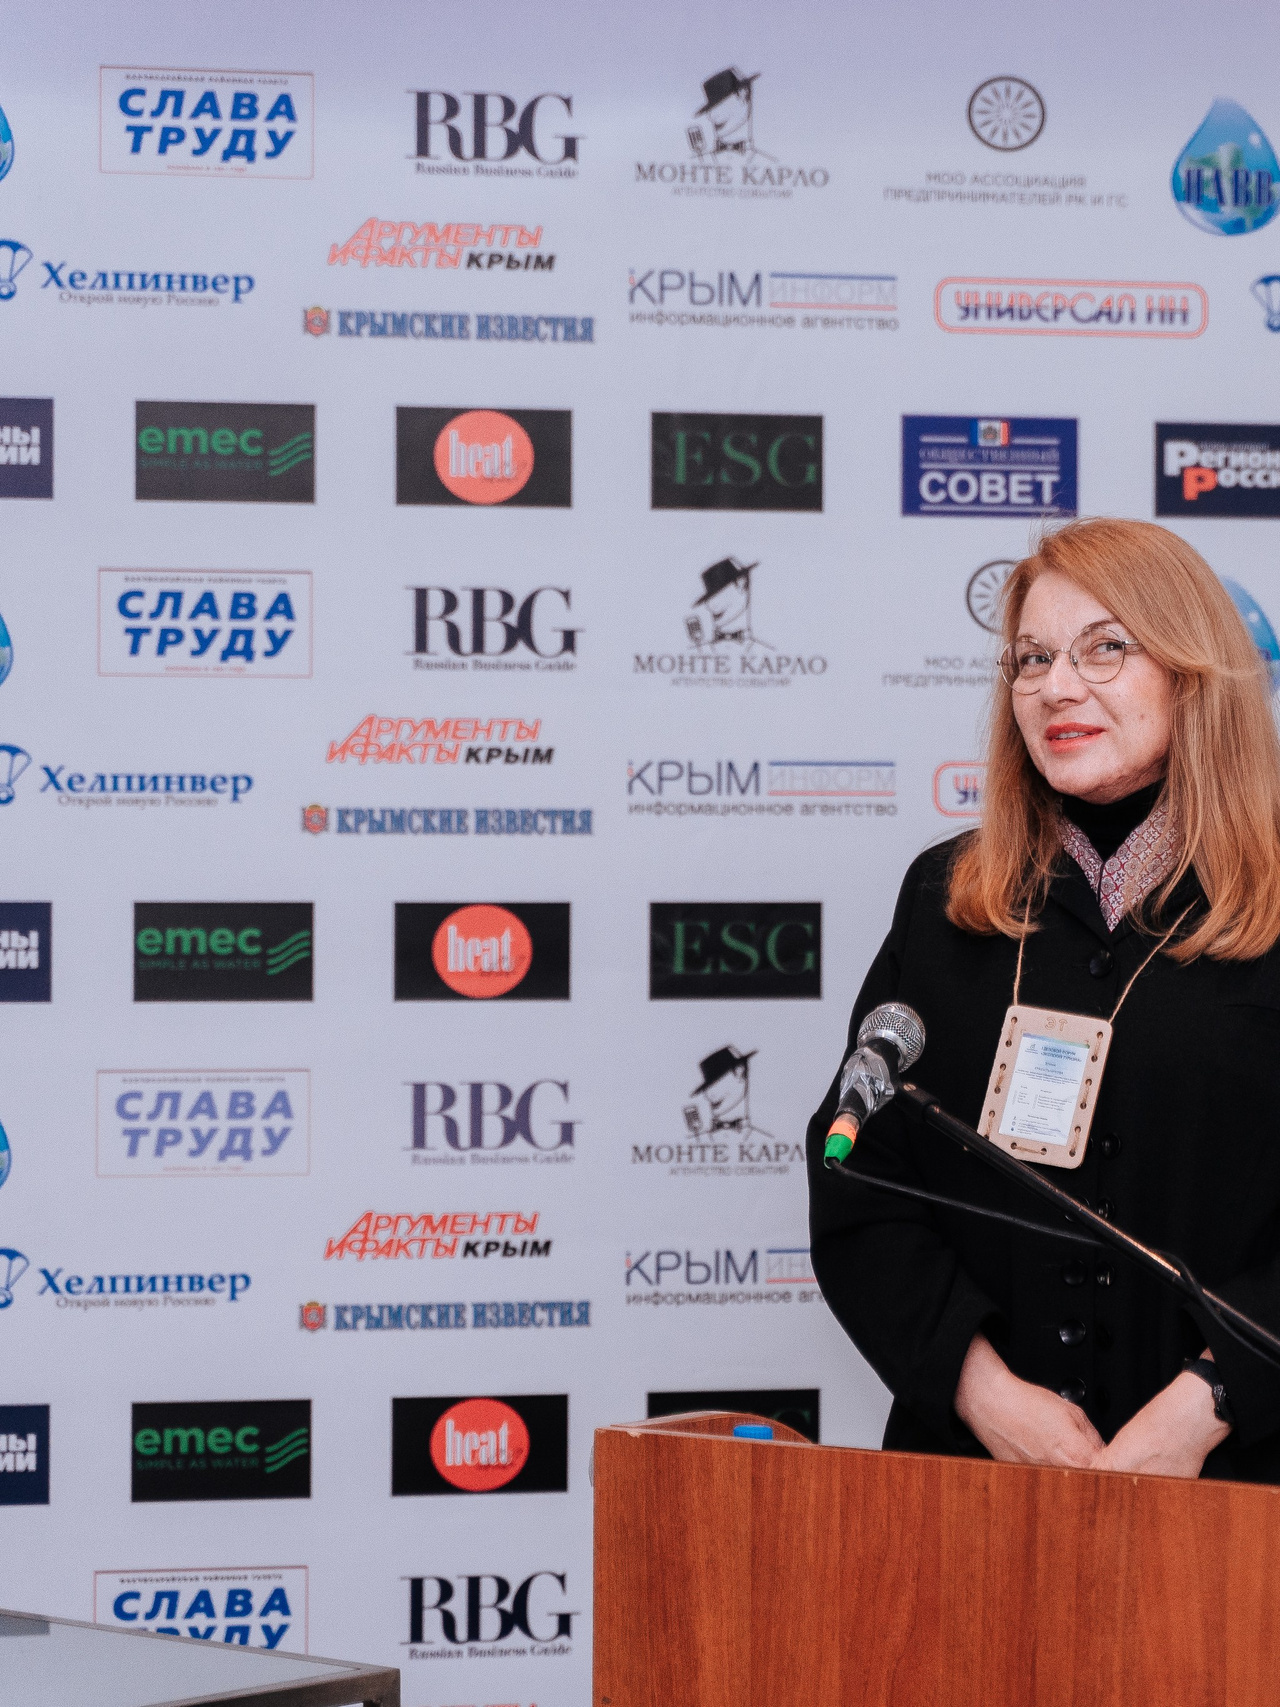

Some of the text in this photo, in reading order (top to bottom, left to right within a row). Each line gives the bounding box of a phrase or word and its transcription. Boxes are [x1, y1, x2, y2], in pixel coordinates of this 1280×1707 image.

[117, 86, 299, 124] СЛАВА
[404, 88, 588, 166] RBG
[124, 124, 298, 164] ТРУДУ
[473, 164, 533, 178] Business
[635, 161, 830, 189] МОНТЕ КАРЛО
[465, 252, 556, 272] КРЫМ
[41, 261, 255, 304] Хелпинвер
[338, 311, 595, 343] КРЫМСКИЕ ИЗВЕСТИЯ
[629, 311, 899, 332] информационное агентство
[138, 426, 264, 457] emec
[672, 430, 817, 487] ESG
[919, 471, 1060, 504] СОВЕТ
[117, 591, 297, 621] СЛАВА
[403, 586, 586, 658] RBG
[124, 627, 296, 664] ТРУДУ
[472, 658, 531, 671] Business
[633, 655, 828, 676] МОНТЕ КАРЛО
[464, 747, 555, 766] КРЫМ
[41, 765, 254, 805] Хелпинвер
[336, 808, 594, 836] КРЫМСКИЕ ИЗВЕСТИЯ
[628, 801, 898, 817] информационное агентство
[136, 927, 263, 956] emec
[671, 920, 815, 975] ESG
[115, 1090, 294, 1121] СЛАВА
[402, 1079, 583, 1153] RBG
[121, 1127, 293, 1161] ТРУДУ
[631, 1144, 806, 1163] МОНТЕ КАРЛ
[463, 1240, 552, 1258] КРЫМ
[37, 1267, 251, 1302] Хелпинвер
[334, 1301, 591, 1331] КРЫМСКИЕ ИЗВЕСТИЯ
[135, 1425, 259, 1457] emec
[445, 1418, 511, 1467] heat
[114, 1587, 291, 1621] СЛАВА
[400, 1572, 581, 1645] RBG
[468, 1646, 527, 1659] Business
